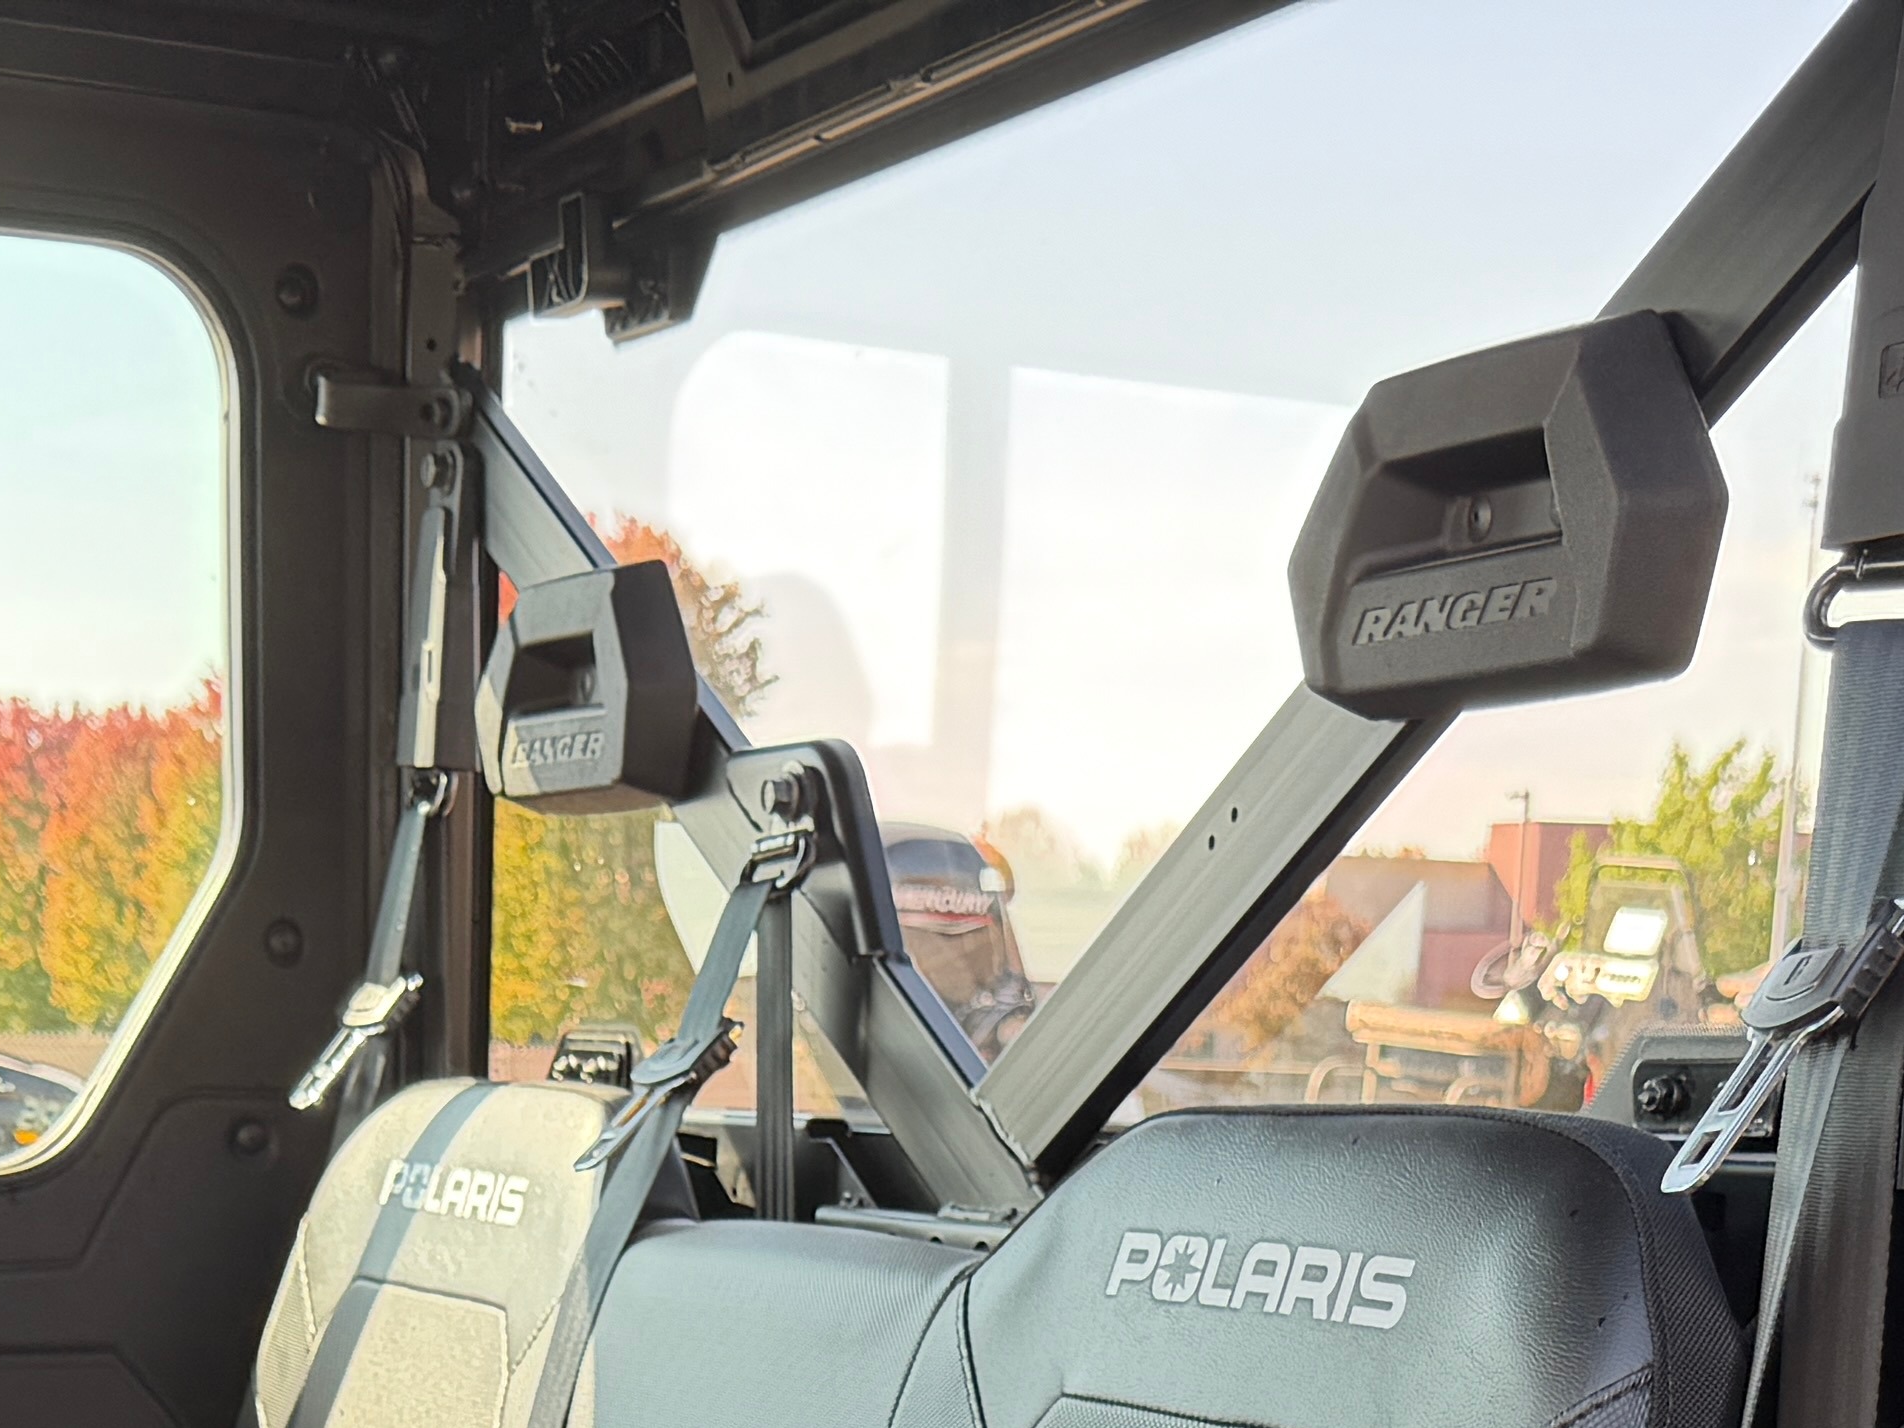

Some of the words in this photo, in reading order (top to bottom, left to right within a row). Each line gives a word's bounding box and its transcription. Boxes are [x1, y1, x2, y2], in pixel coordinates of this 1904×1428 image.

[1352, 577, 1557, 646] RANGER
[379, 1159, 530, 1226] POLARIS
[1105, 1231, 1416, 1329] POLARIS
